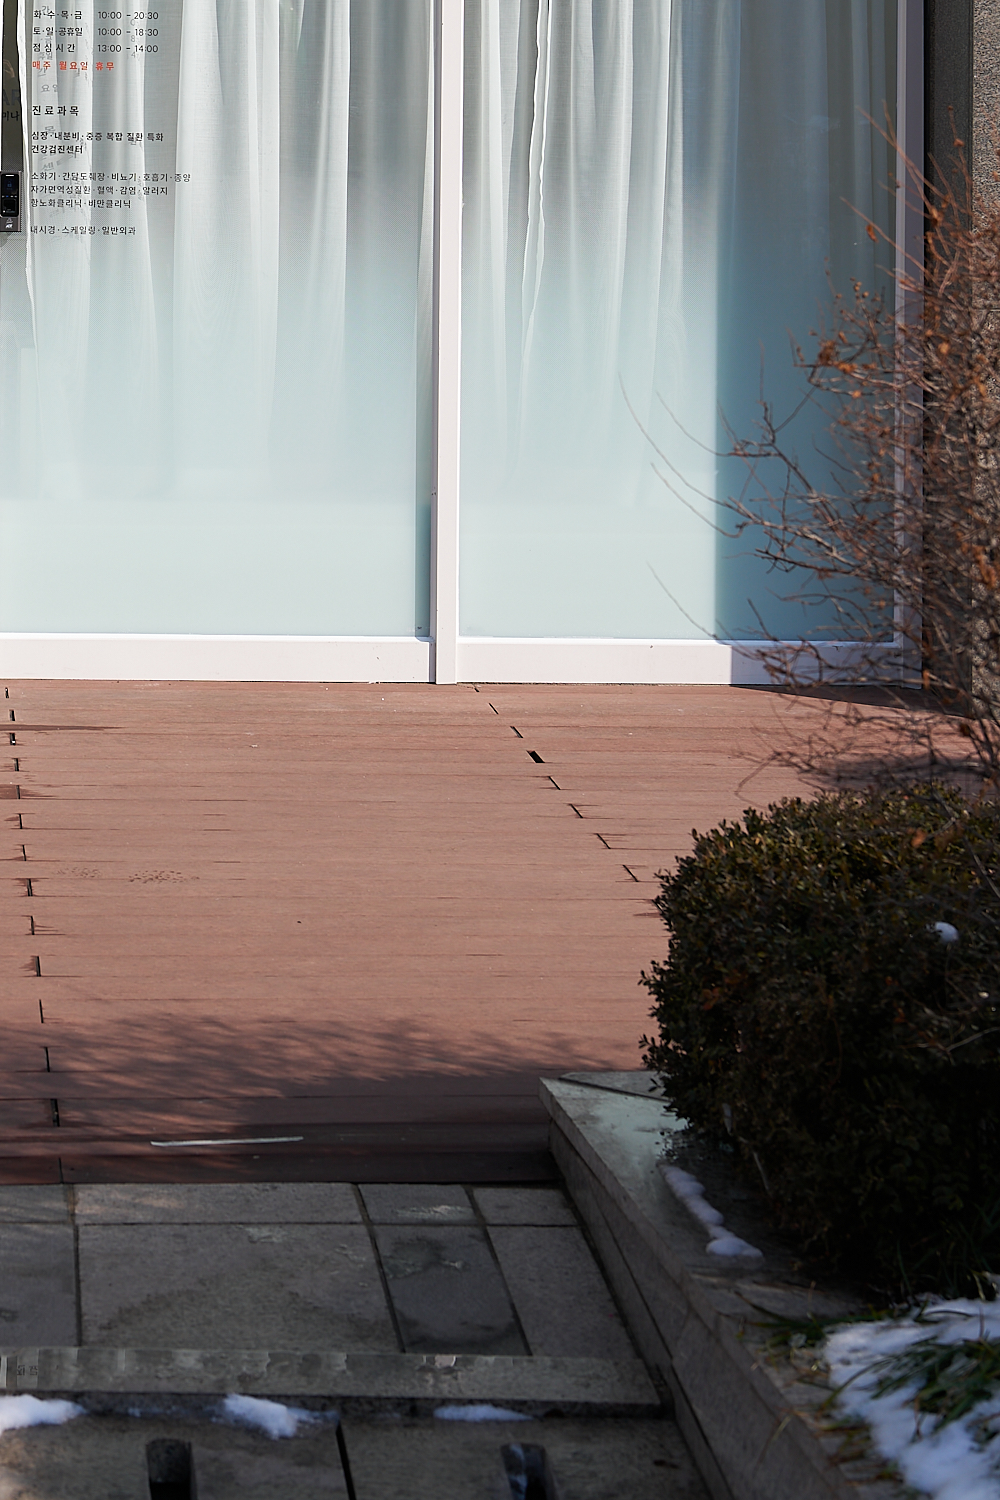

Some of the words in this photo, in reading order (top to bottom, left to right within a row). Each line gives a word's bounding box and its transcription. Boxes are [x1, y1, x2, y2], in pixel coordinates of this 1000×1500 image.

[98, 11, 122, 20] 10:00
[134, 11, 159, 20] 20:30
[98, 28, 122, 37] 10:00
[135, 28, 159, 37] 18:30
[97, 44, 122, 53] 13:00
[135, 44, 159, 53] 14:00
[32, 60, 51, 71] 매주
[59, 60, 89, 71] 월요일
[95, 61, 115, 71] 휴무
[32, 105, 80, 117] 진료과목
[106, 132, 123, 142] 복합
[126, 132, 143, 142] 질환
[147, 132, 164, 142] 특화
[31, 145, 83, 154] 건강검진센터
